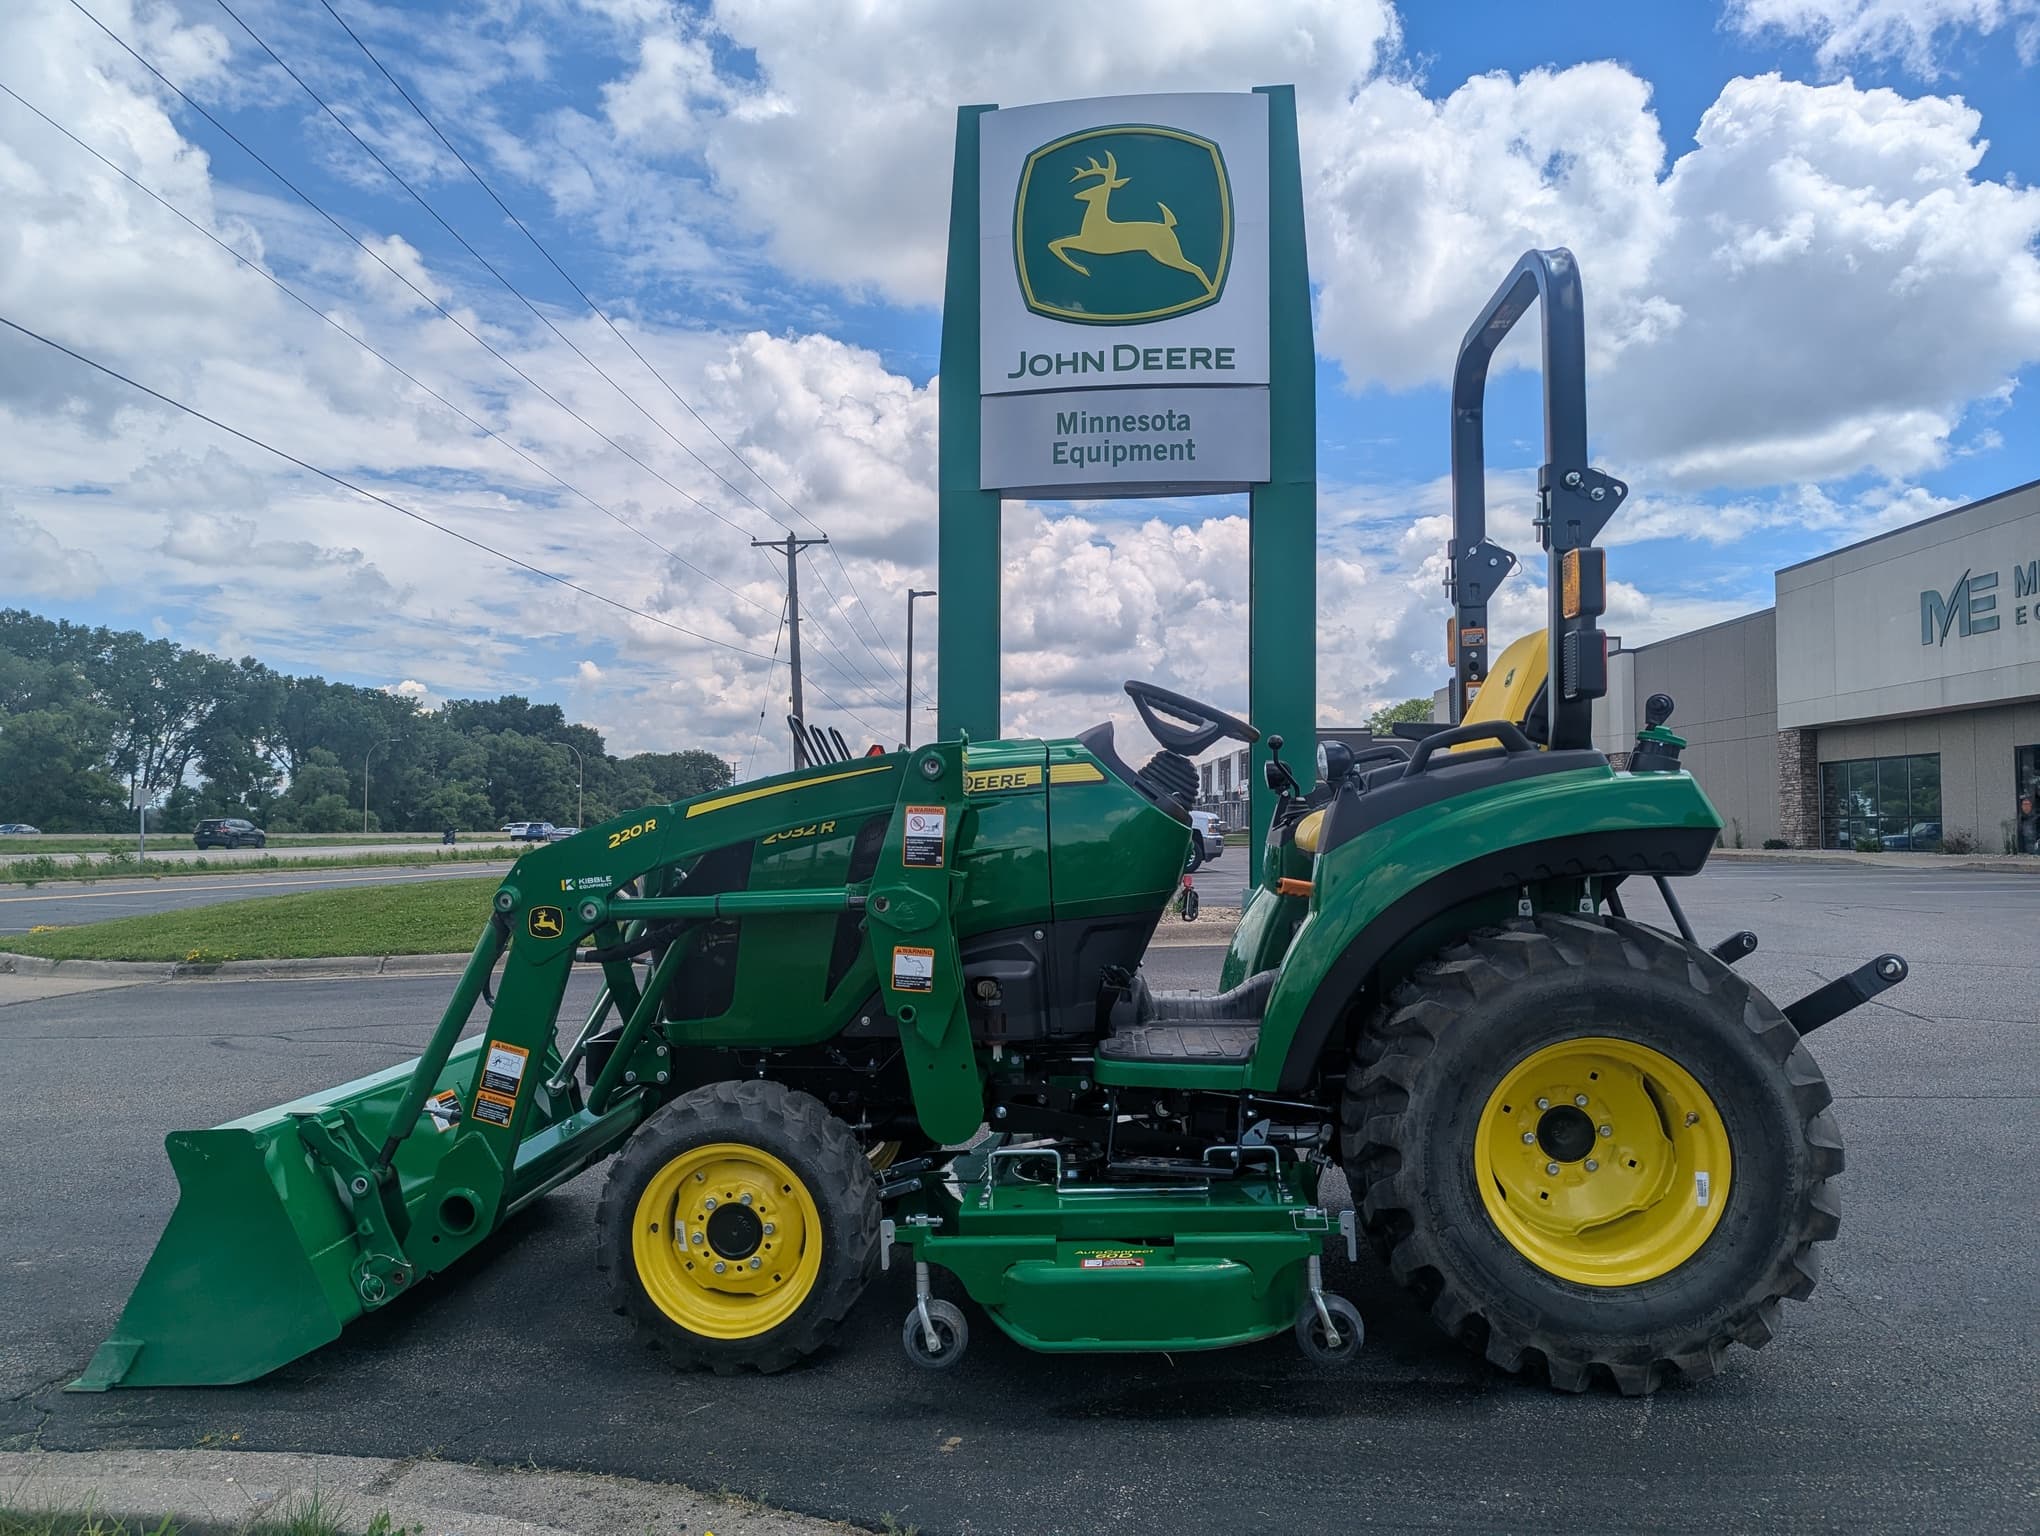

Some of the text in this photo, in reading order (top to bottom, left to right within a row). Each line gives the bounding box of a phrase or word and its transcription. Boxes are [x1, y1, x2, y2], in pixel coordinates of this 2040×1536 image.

[1007, 343, 1236, 379] JOHN DEERE
[1055, 409, 1191, 435] Minnesota
[1052, 438, 1196, 468] Equipment
[2014, 560, 2040, 598] M
[578, 875, 613, 885] KIBBLE
